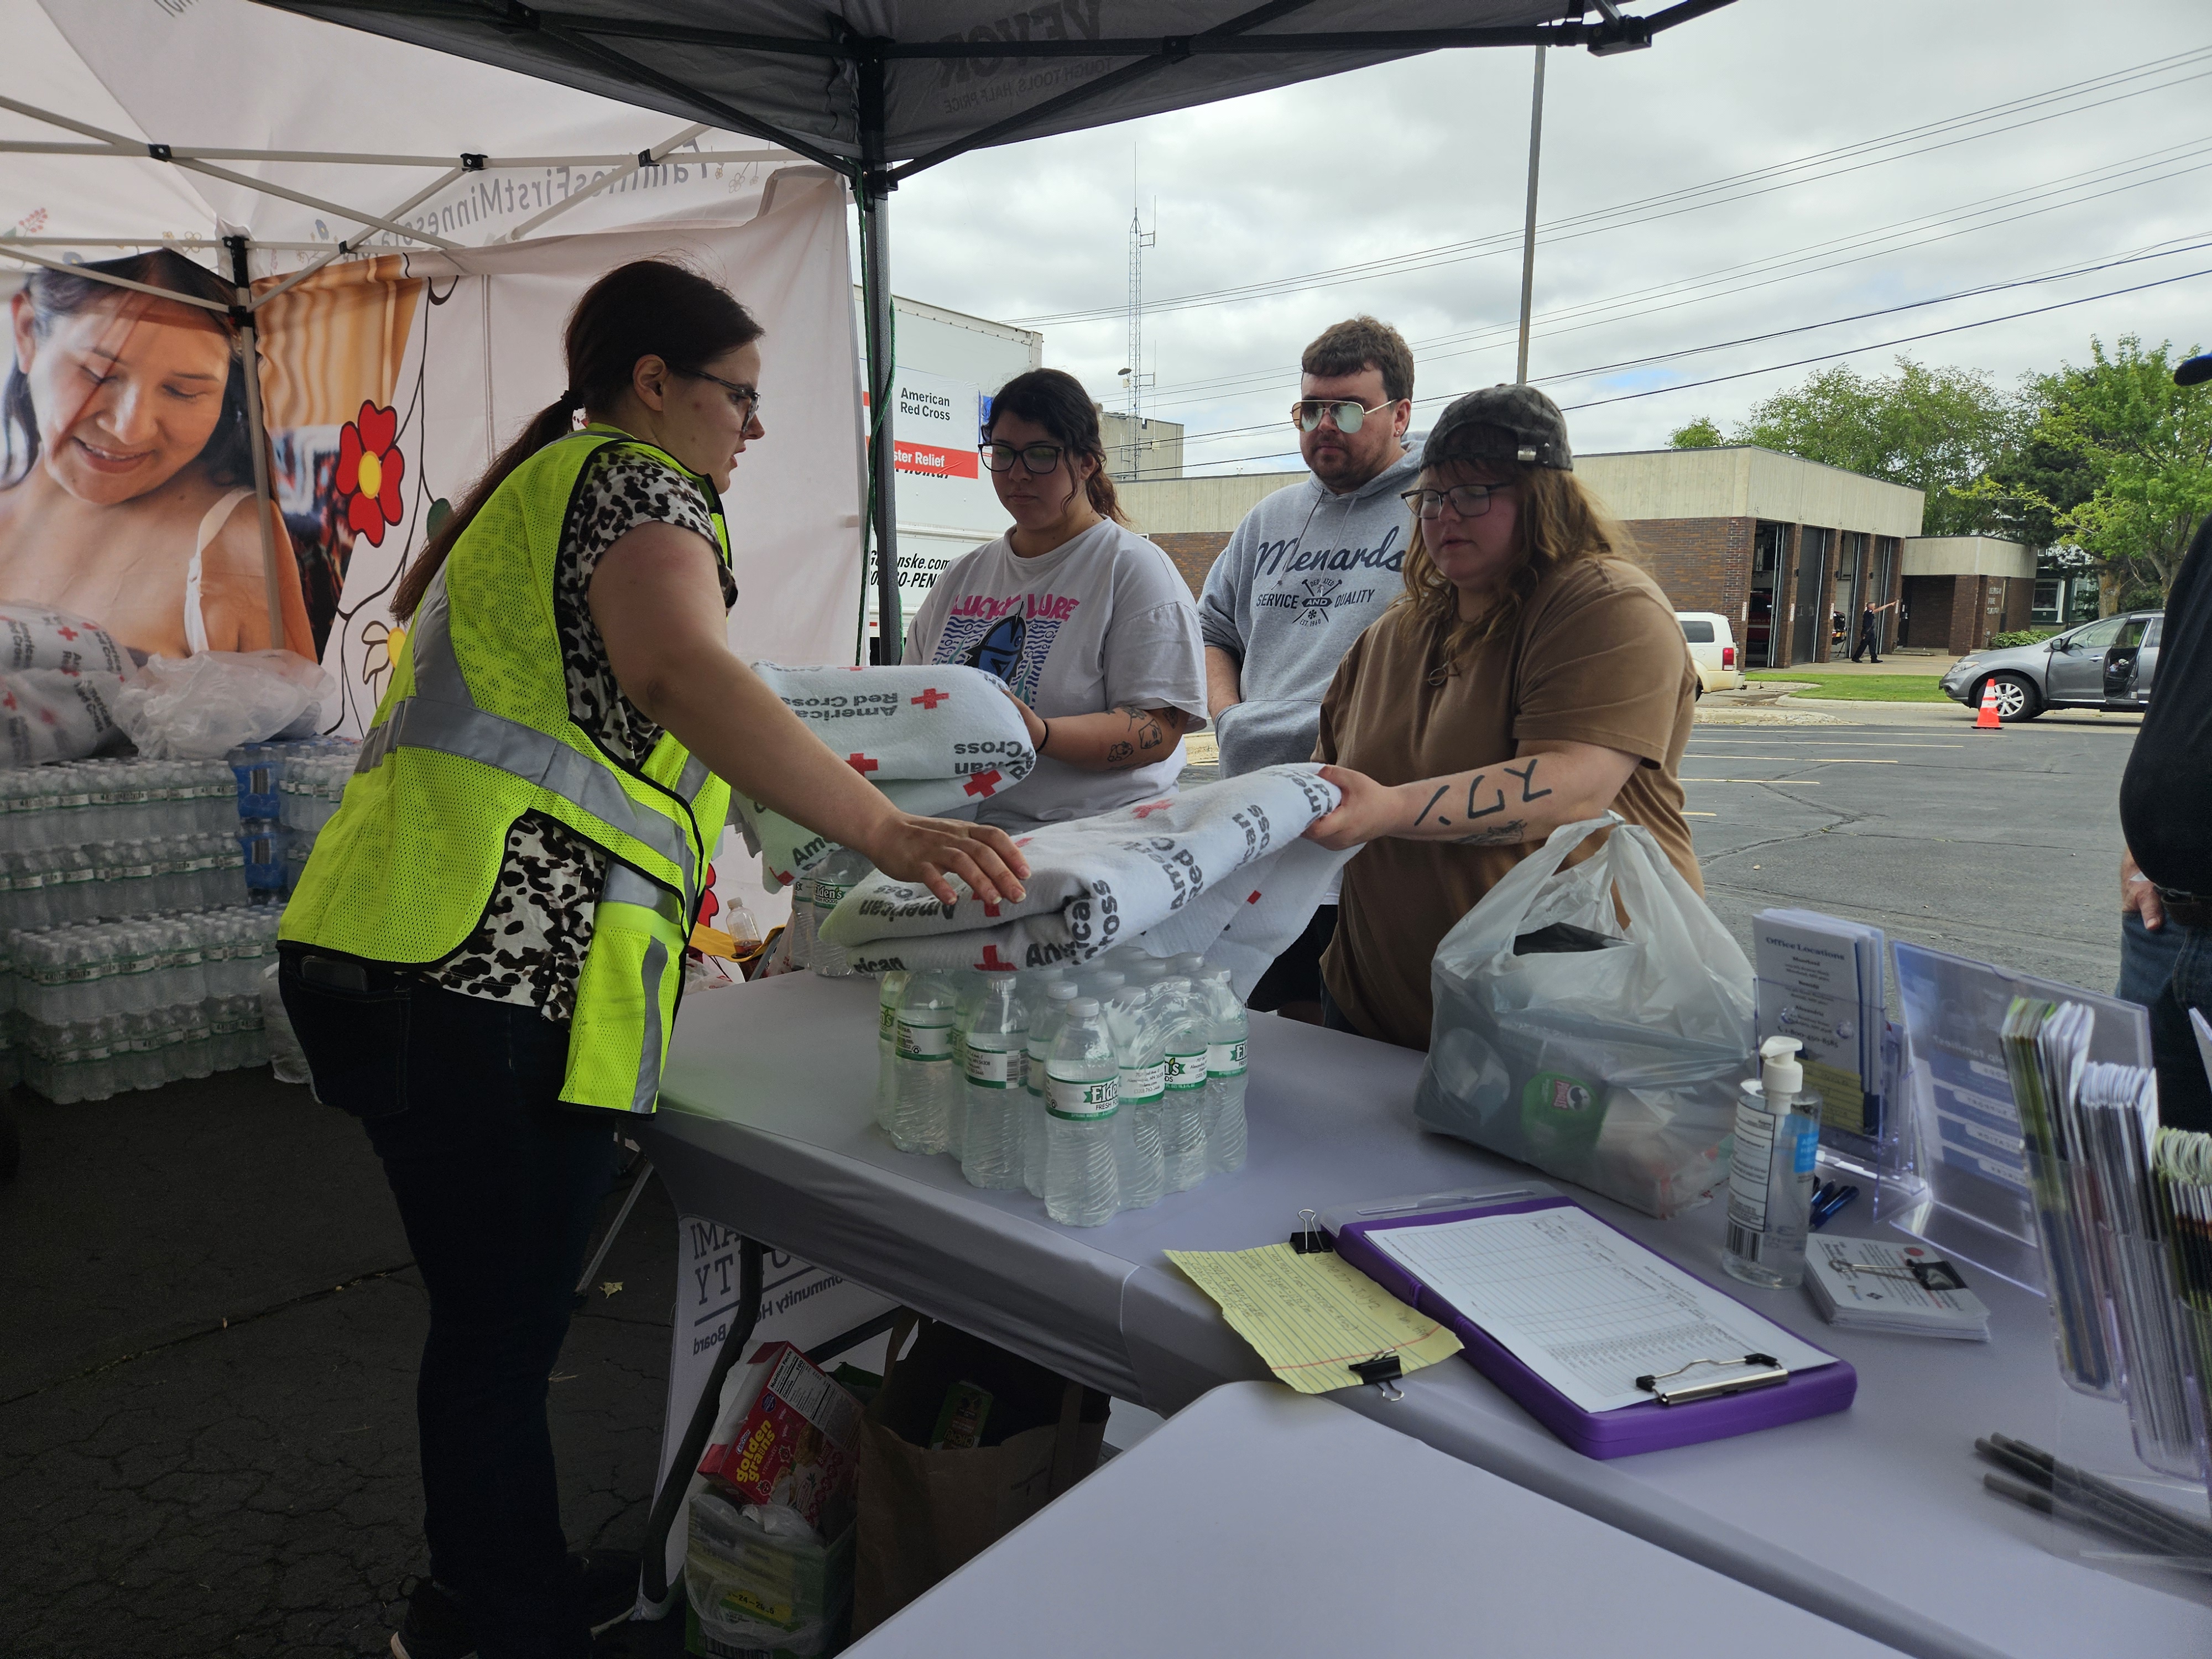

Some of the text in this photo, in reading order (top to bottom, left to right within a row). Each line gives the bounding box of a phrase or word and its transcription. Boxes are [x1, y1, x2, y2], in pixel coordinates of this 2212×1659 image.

[901, 387, 950, 406] American
[900, 401, 950, 421] Red Cross
[894, 450, 945, 468] ster Relief
[1254, 526, 1406, 580] Menards
[1311, 578, 1335, 587] DEDATED
[950, 594, 1080, 622] LUCKY LURE
[1256, 593, 1300, 609] SERVICE
[1334, 589, 1375, 608] QUALITY
[854, 692, 898, 706] Red
[793, 705, 898, 721] America
[954, 741, 1023, 758] Cross
[815, 885, 842, 899] lden's
[859, 899, 957, 922] American
[1766, 937, 1845, 960] Office Locations
[1091, 1080, 1118, 1104] Elde
[1314, 1251, 1339, 1275] June
[770, 1350, 792, 1389] Nutrition Facts
[736, 1420, 772, 1483] golden
